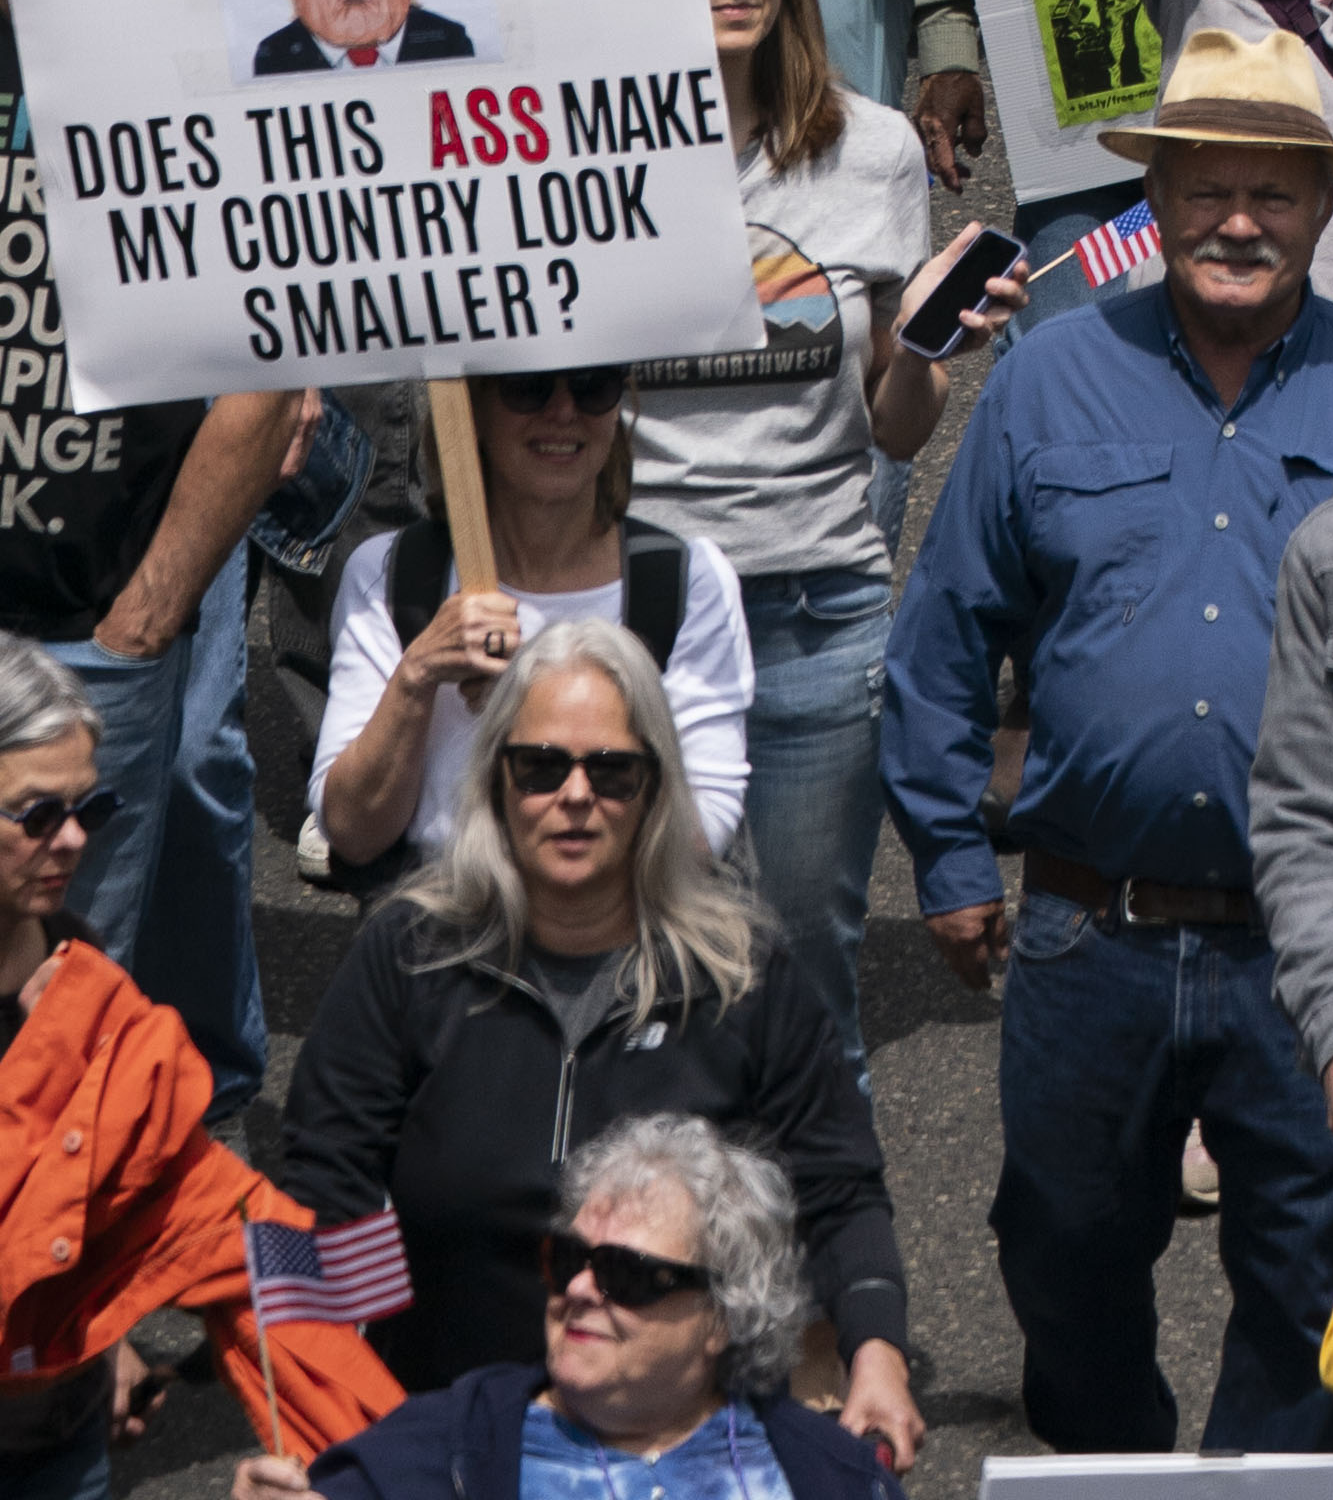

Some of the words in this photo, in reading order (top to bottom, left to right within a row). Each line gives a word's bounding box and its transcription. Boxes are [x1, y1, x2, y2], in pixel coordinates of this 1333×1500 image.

[63, 112, 222, 200] DOES
[245, 98, 385, 186] THIS
[428, 84, 551, 171] ASS
[559, 66, 724, 157] MAKE
[106, 200, 200, 286] MY
[220, 177, 483, 274] COUNTRY
[507, 162, 660, 250] LOOK
[243, 257, 583, 363] SMALLER?
[697, 346, 835, 380] NORTHWEST
